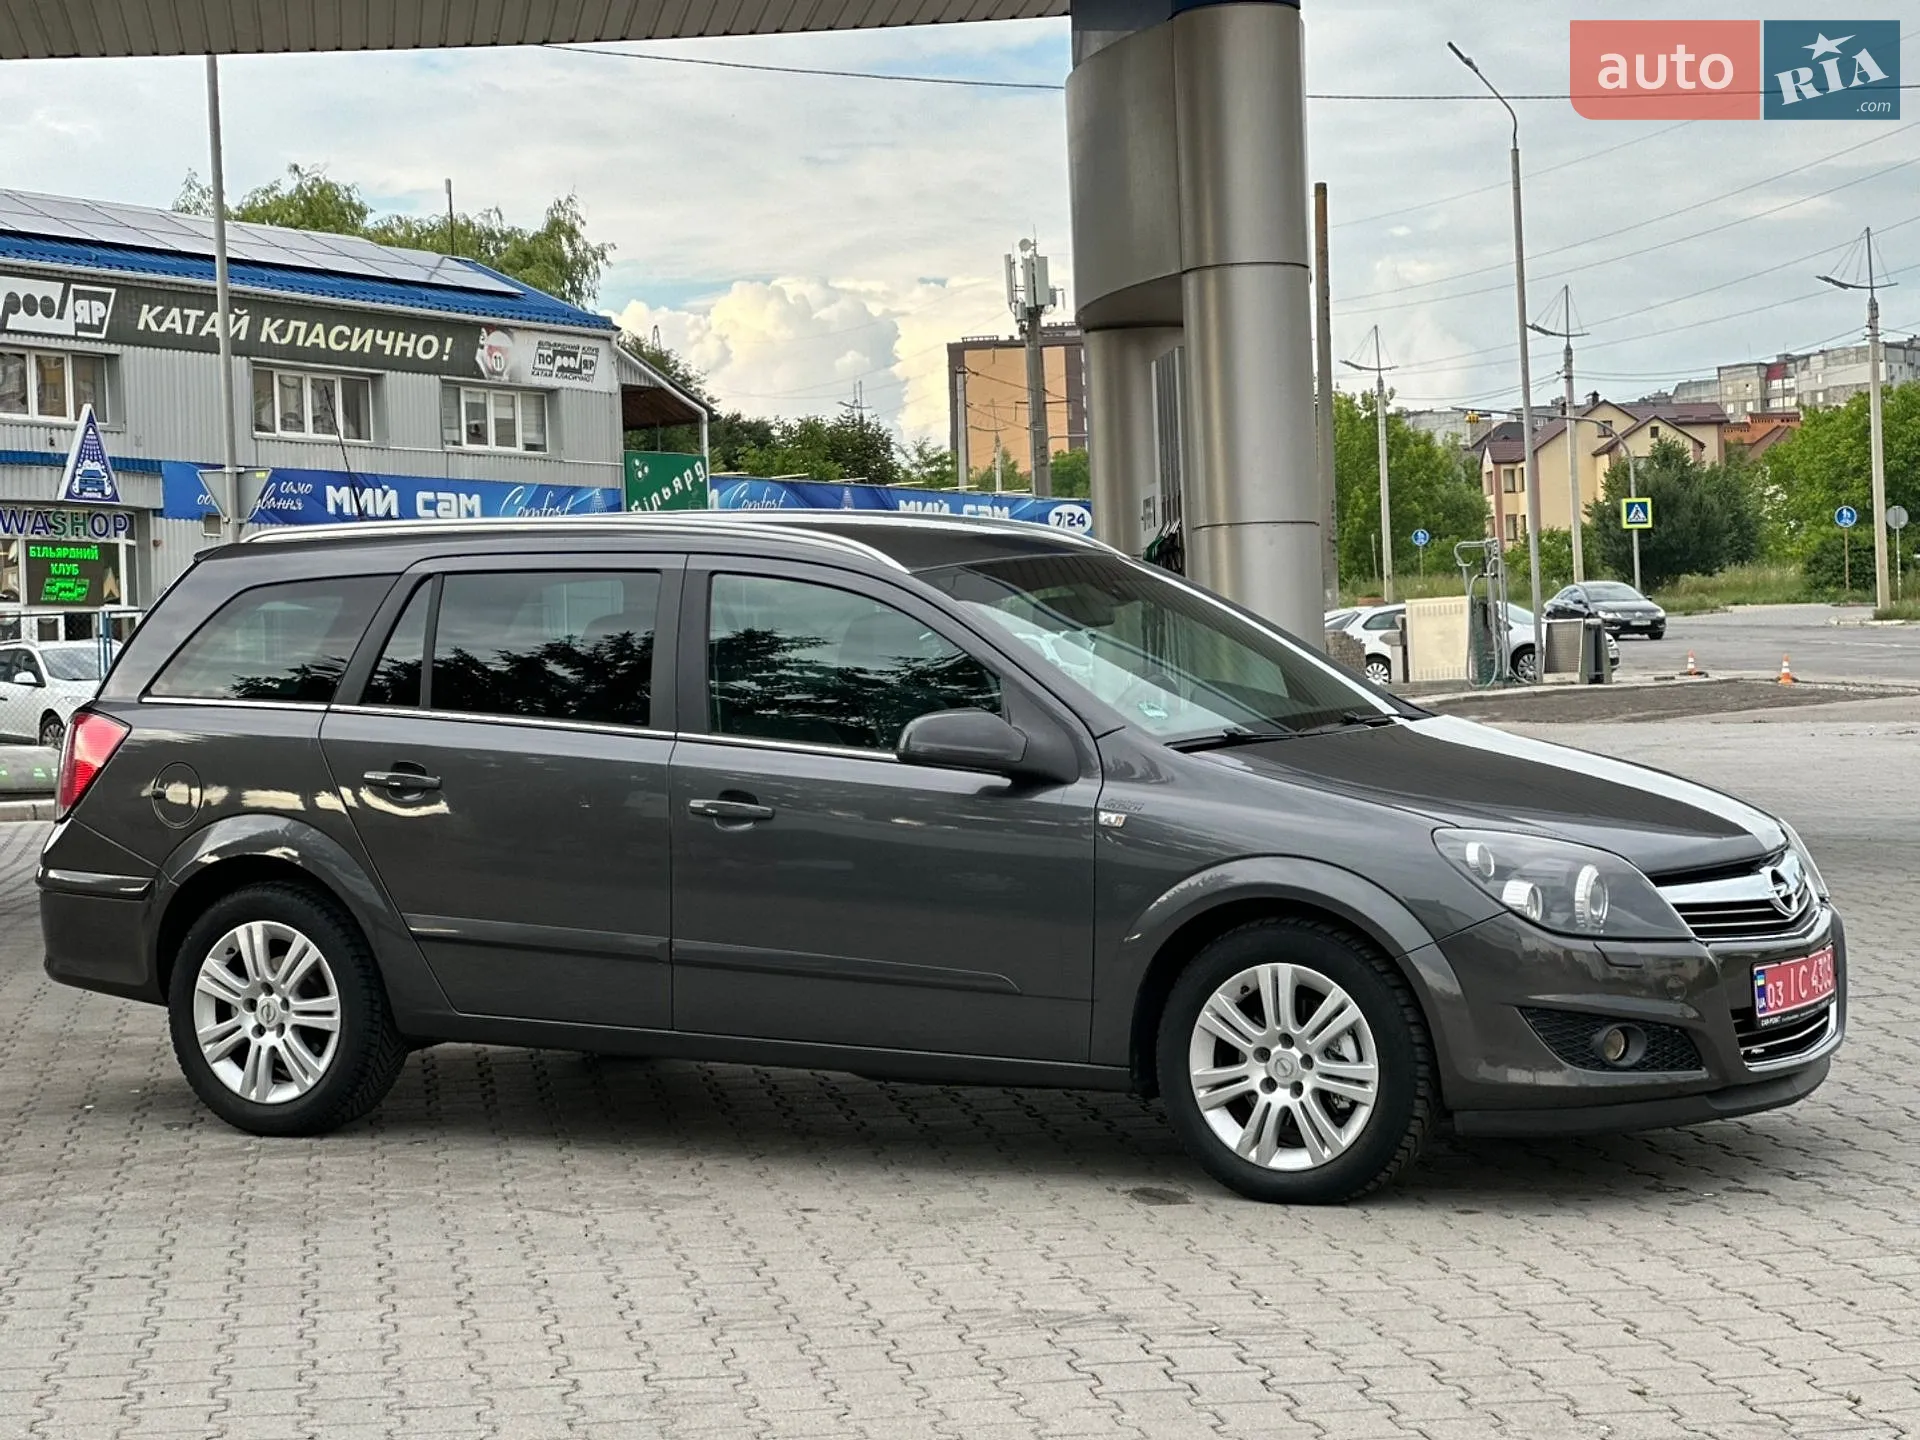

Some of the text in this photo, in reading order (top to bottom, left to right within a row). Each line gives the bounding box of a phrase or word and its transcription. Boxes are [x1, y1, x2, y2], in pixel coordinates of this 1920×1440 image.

[75, 299, 107, 326] ЯР
[137, 304, 453, 361] КАТАЙ КЛАСИЧНО!
[538, 353, 552, 365] ПО
[583, 359, 595, 371] ЯР
[29, 544, 99, 561] БІЛЬЯРДНИЙ
[50, 563, 80, 576] КЛУБ
[1767, 980, 1784, 1009] 03
